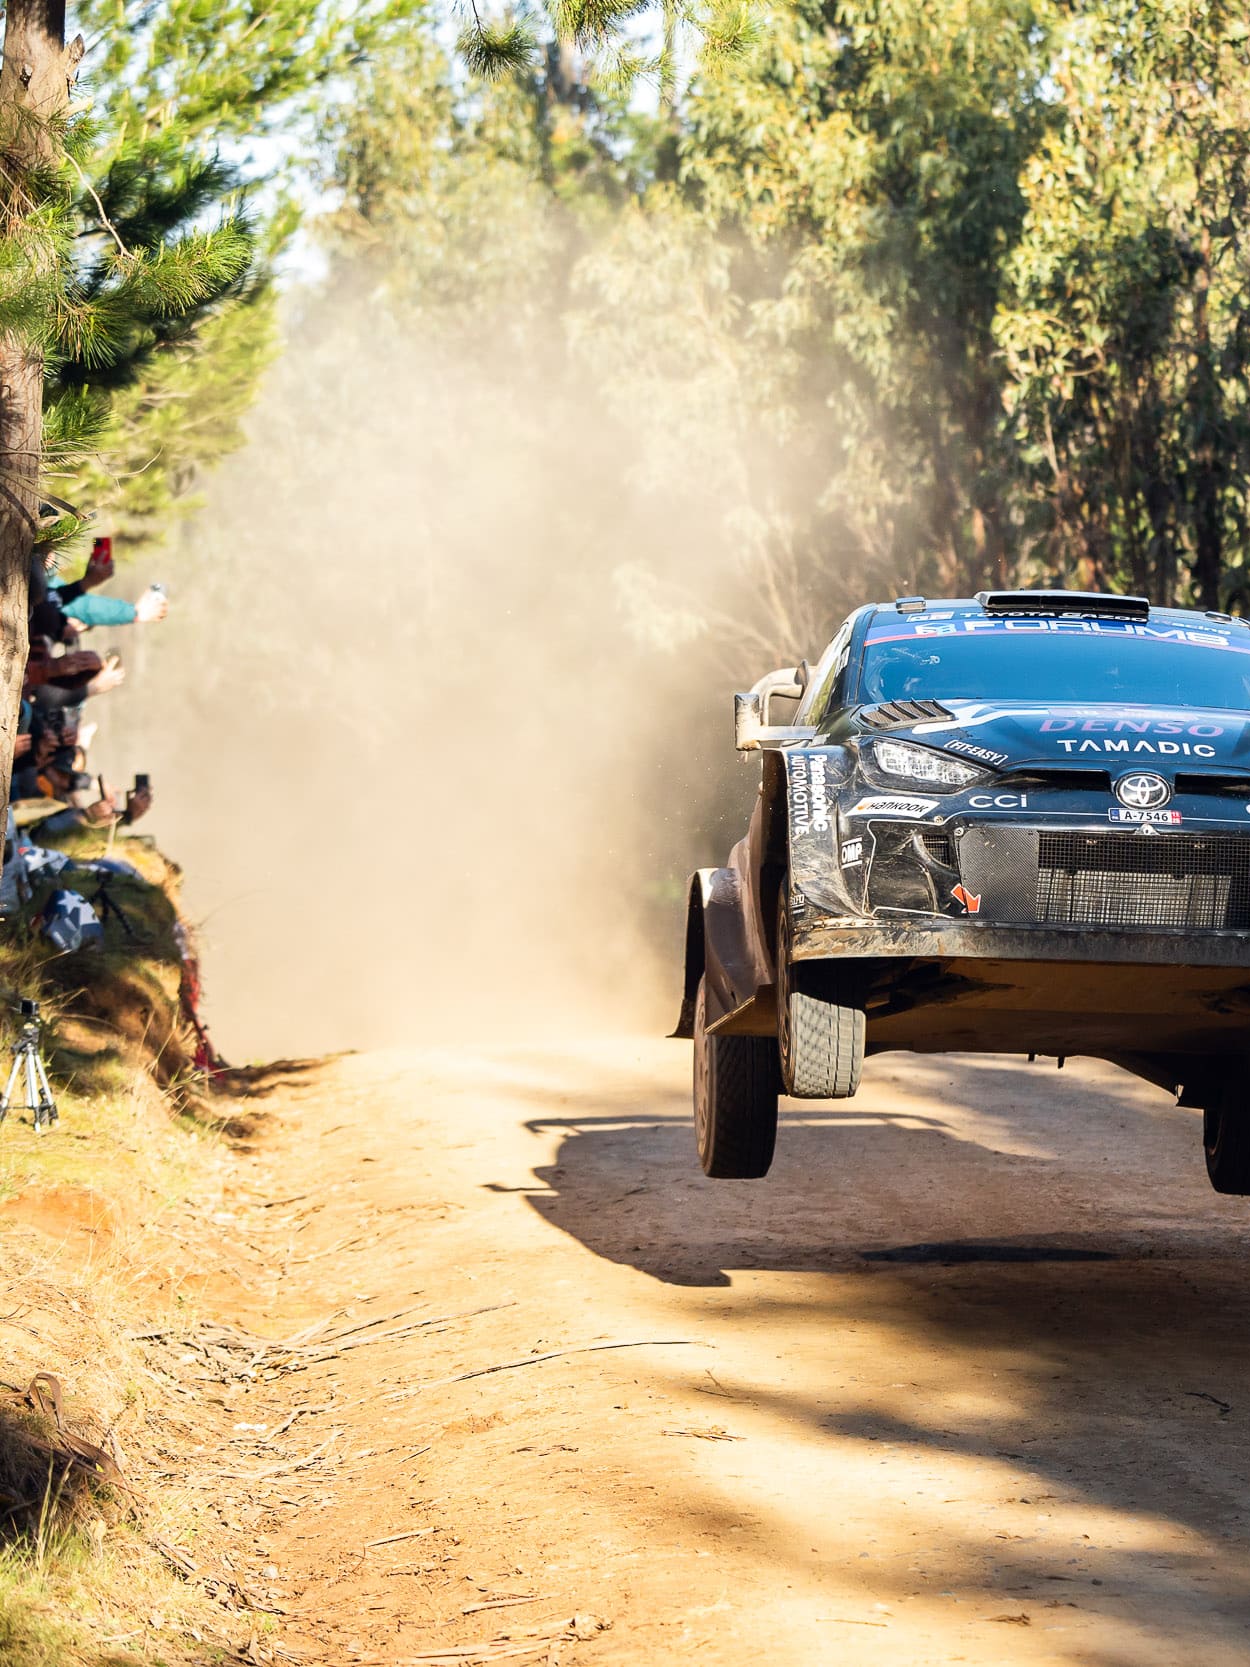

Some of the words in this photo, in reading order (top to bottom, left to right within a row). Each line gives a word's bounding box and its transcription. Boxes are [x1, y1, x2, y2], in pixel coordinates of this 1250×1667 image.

[1058, 612, 1148, 622] GAZOO
[1039, 719, 1225, 737] DENSO
[1056, 739, 1216, 758] TAMADIC
[790, 755, 811, 836] AUTOMOTIVE
[809, 754, 833, 832] Panasonic
[1124, 810, 1169, 822] A-7546
